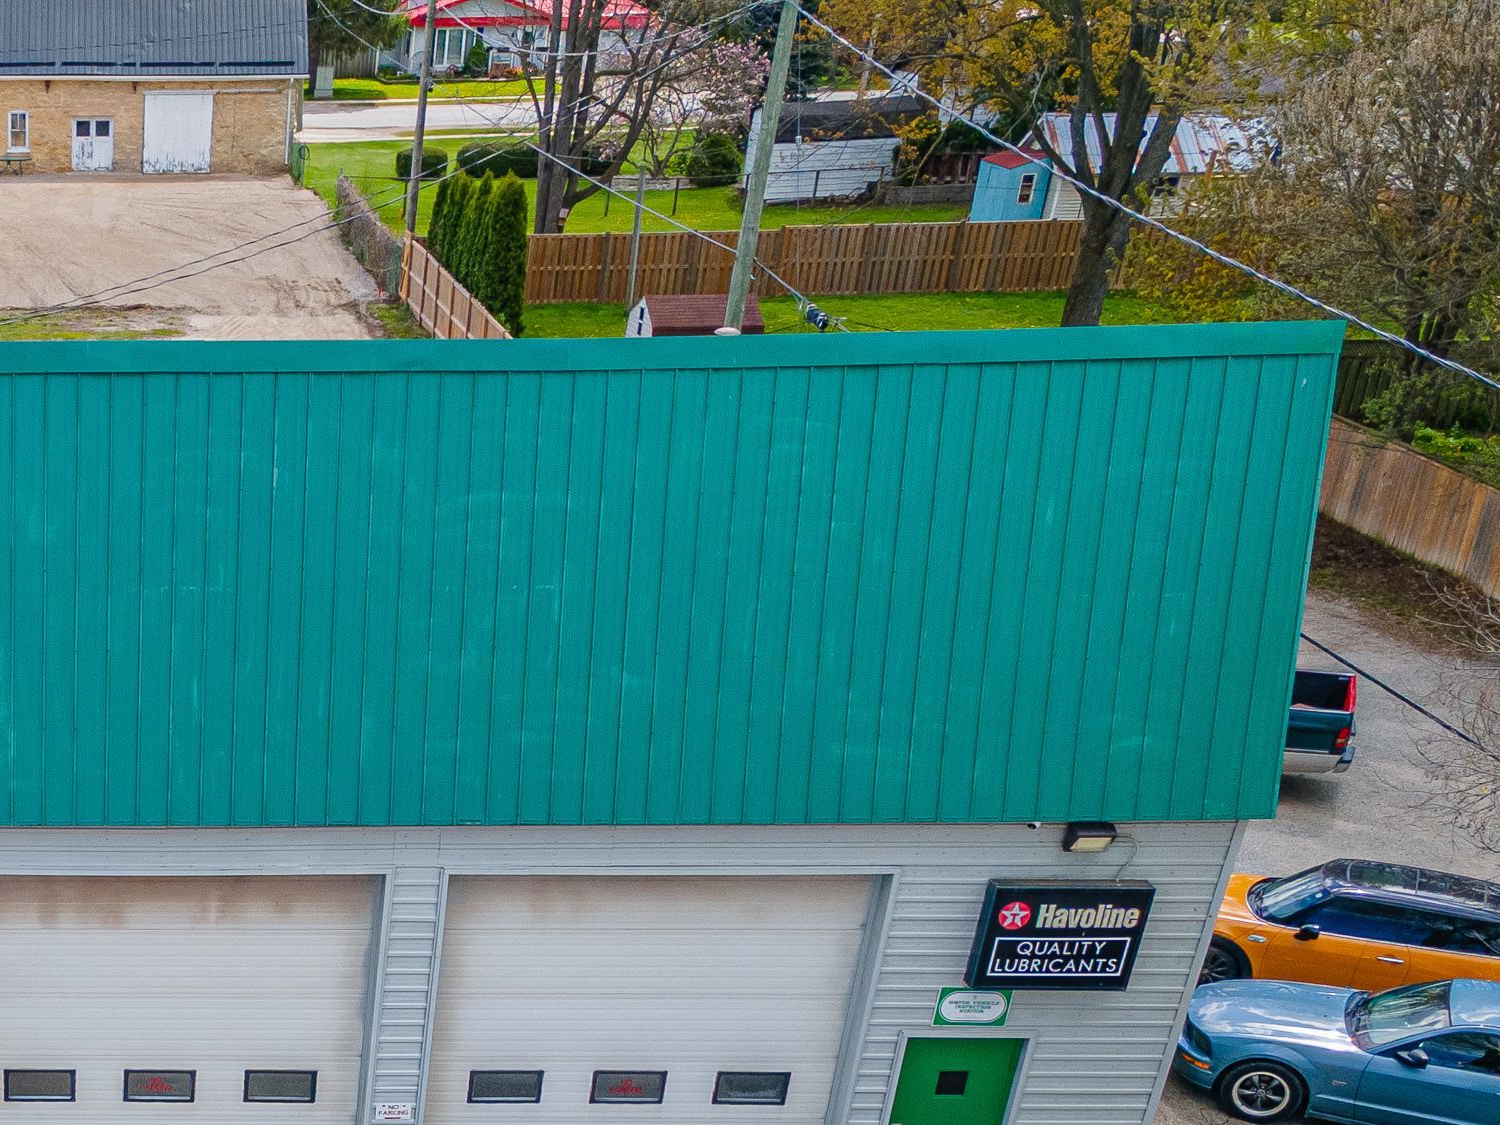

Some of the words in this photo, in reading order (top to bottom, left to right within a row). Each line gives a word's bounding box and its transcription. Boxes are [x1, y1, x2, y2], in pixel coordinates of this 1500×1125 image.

[1035, 904, 1140, 929] Havoline
[1016, 941, 1108, 956] QUALITY
[993, 958, 1118, 973] LUBRICANTS
